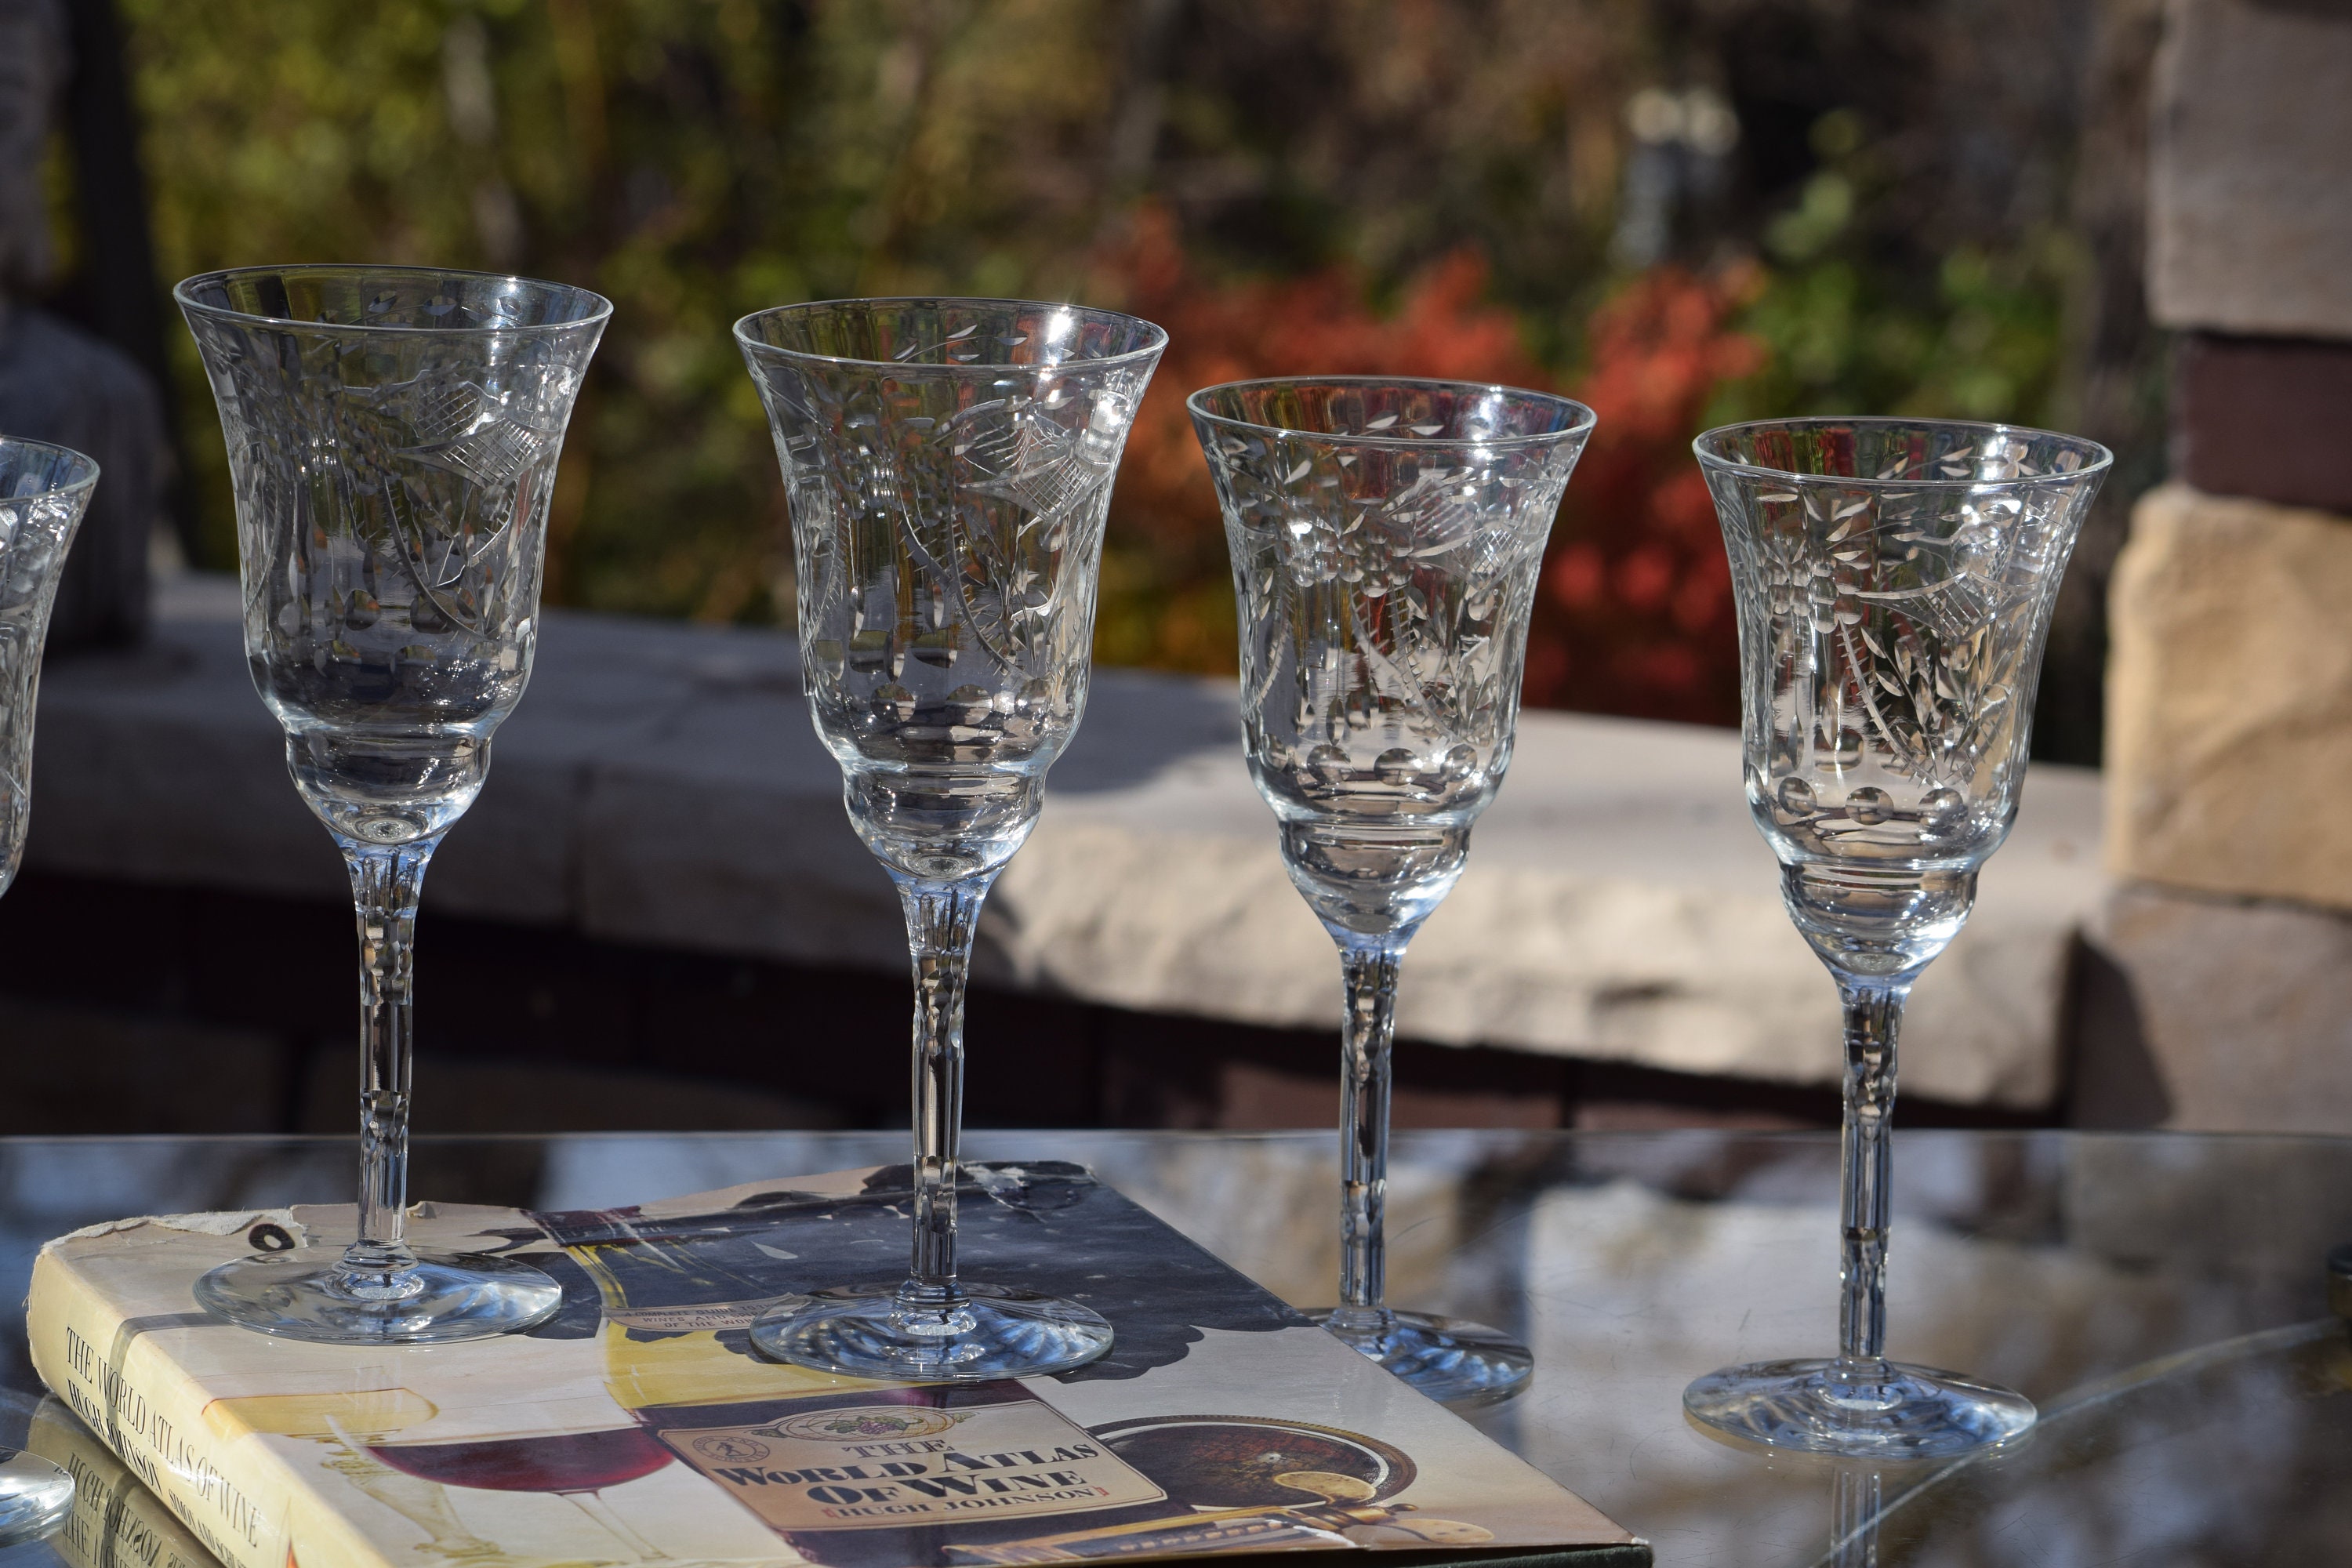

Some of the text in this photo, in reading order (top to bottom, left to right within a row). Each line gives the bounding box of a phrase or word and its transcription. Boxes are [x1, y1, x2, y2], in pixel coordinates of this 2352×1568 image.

[67, 1377, 105, 1436] HUGH
[106, 1417, 163, 1496] JOHNSON
[67, 1326, 258, 1549] THE WORLD ATLAS OF WINE
[841, 1439, 956, 1458] THE
[712, 1443, 1099, 1486] WORLD ATLAS
[807, 1470, 1087, 1505] OF WINE
[837, 1487, 1095, 1517] HUGH JOHNSON
[198, 1518, 216, 1550] AND
